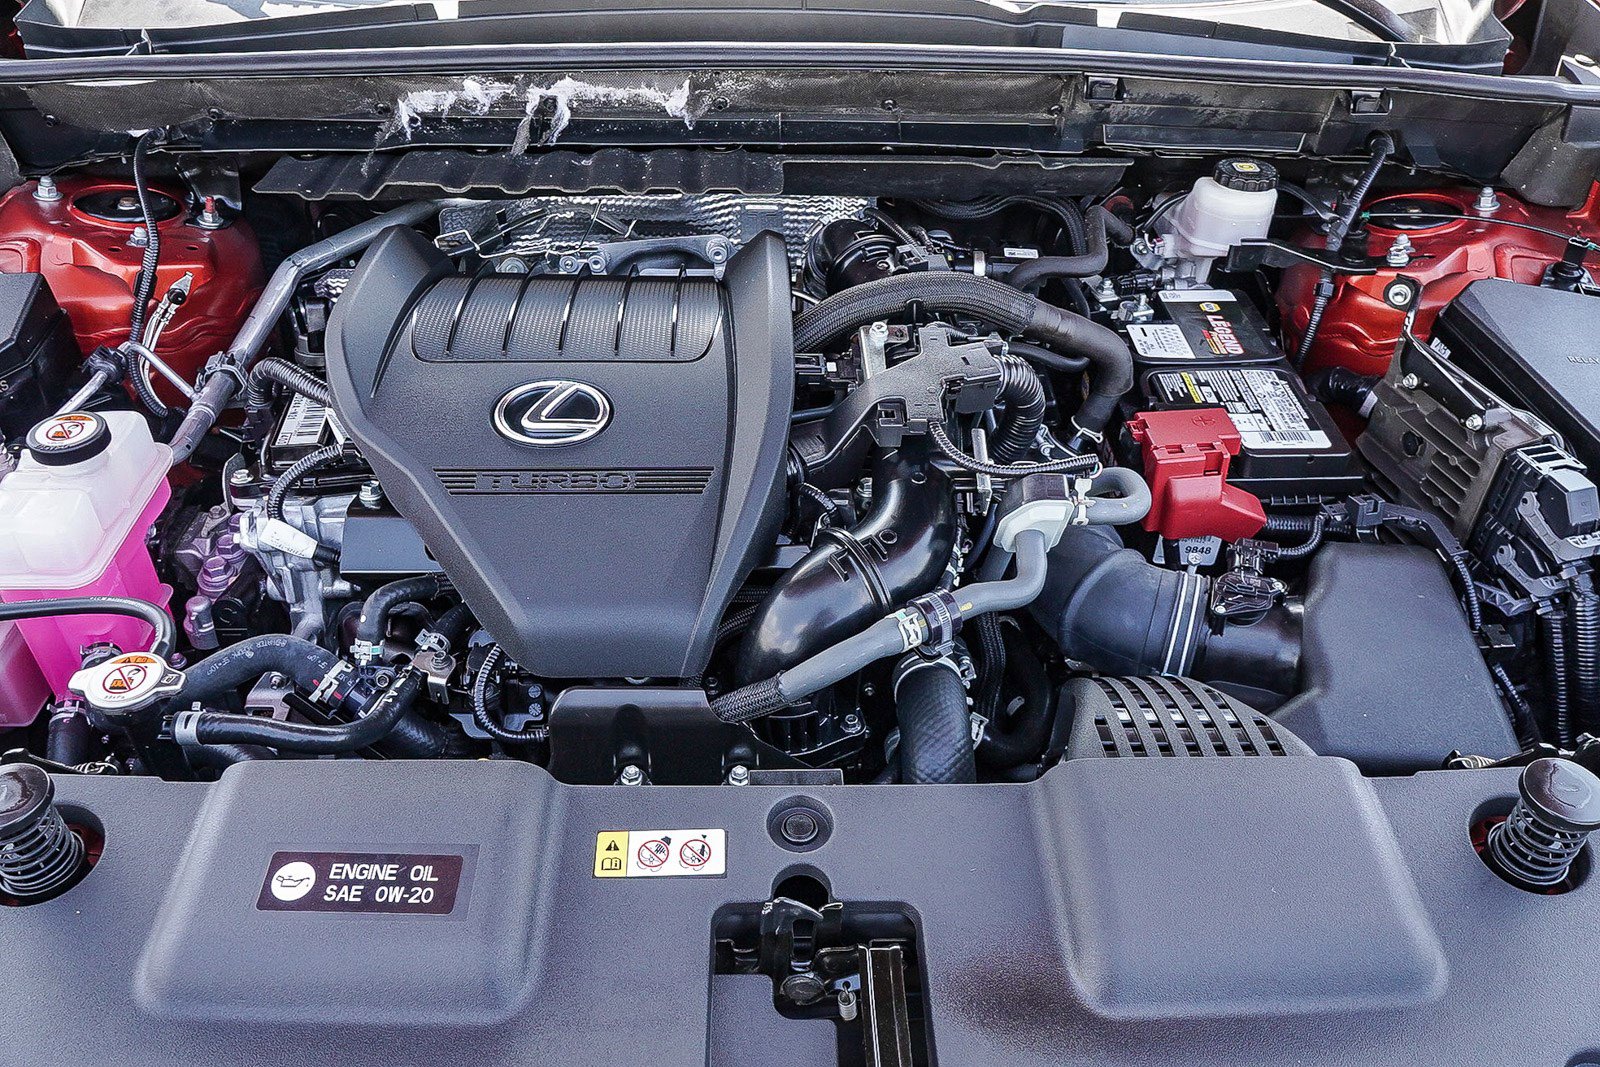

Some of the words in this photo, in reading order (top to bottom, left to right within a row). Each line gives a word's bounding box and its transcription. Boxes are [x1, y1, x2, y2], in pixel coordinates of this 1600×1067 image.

[481, 472, 630, 490] TURBO
[1184, 545, 1212, 555] 9848
[328, 863, 400, 881] ENGINE
[410, 864, 439, 882] OIL
[323, 885, 364, 902] SAE
[374, 886, 434, 903] 0W-20
